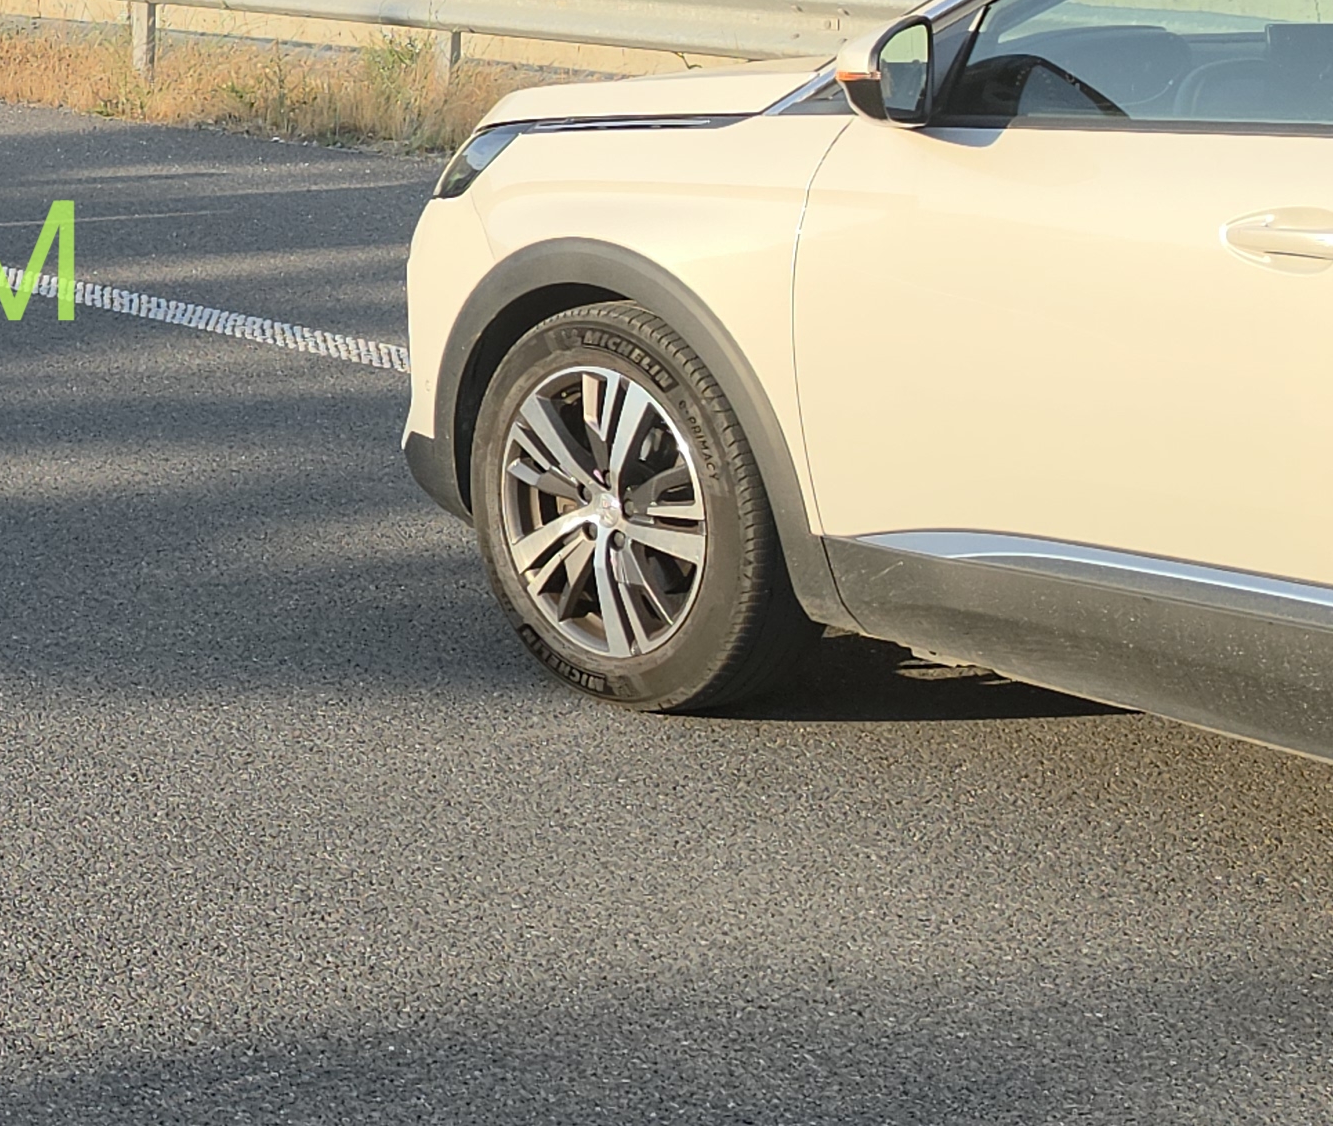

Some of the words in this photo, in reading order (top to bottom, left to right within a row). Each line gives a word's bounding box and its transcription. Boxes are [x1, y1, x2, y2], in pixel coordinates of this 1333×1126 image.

[584, 329, 674, 388] MICHELIN
[678, 399, 720, 481] e-PRIMACY
[520, 627, 605, 692] MICHELIN
